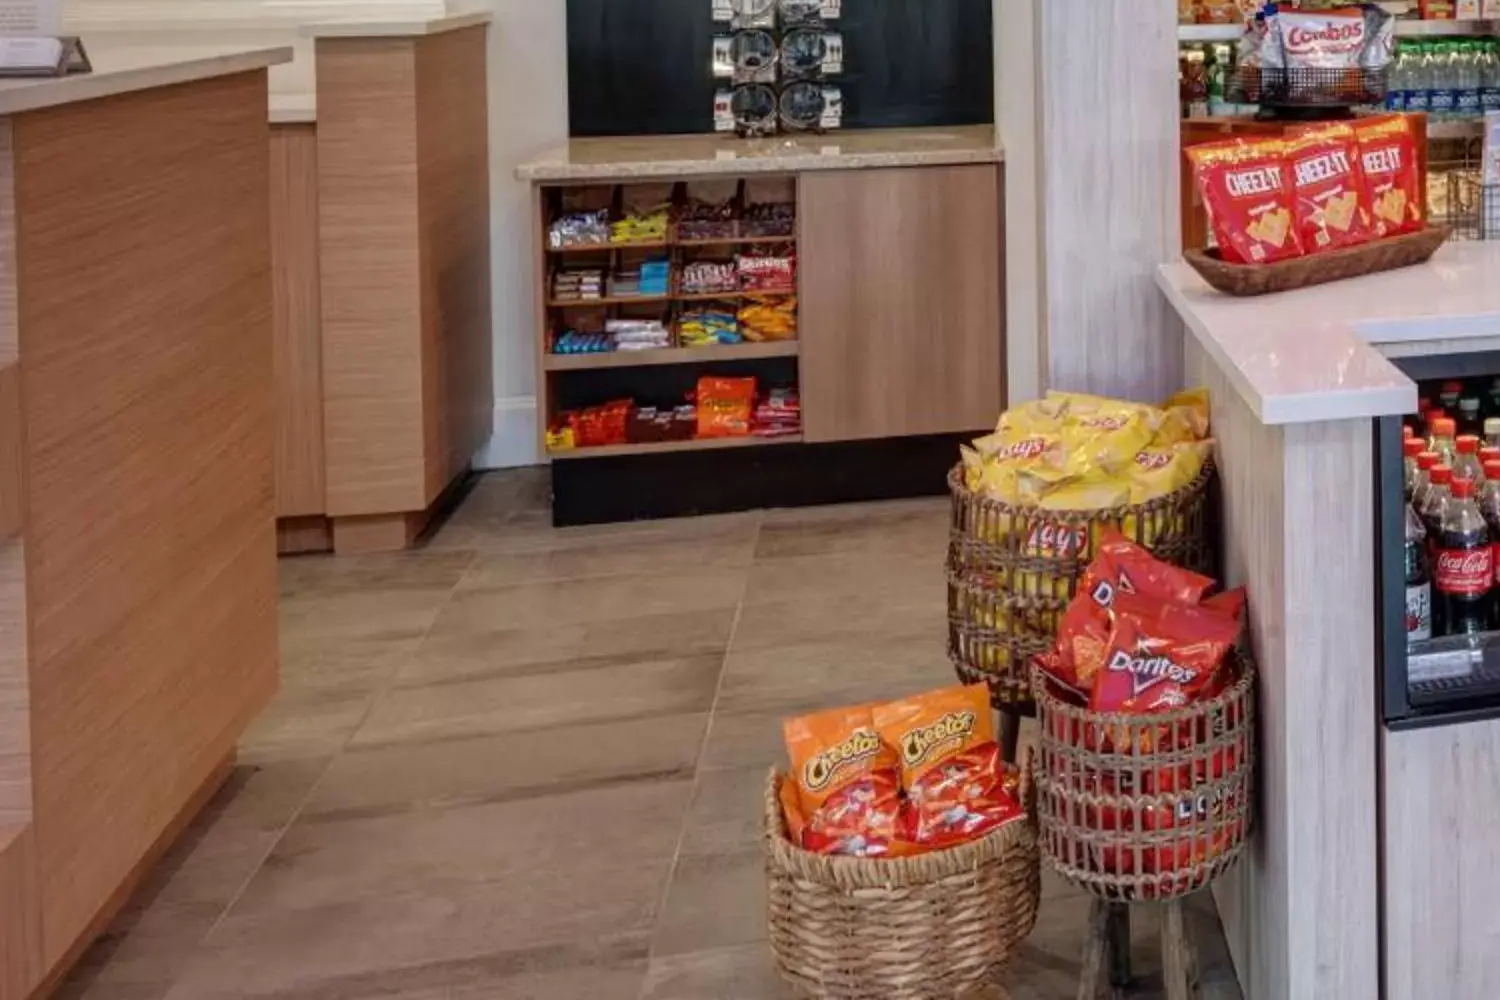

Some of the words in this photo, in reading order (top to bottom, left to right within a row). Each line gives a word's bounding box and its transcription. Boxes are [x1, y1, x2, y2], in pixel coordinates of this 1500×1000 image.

[1287, 22, 1363, 48] Combos
[1108, 650, 1199, 683] Doritos
[903, 711, 977, 768] Cheetos
